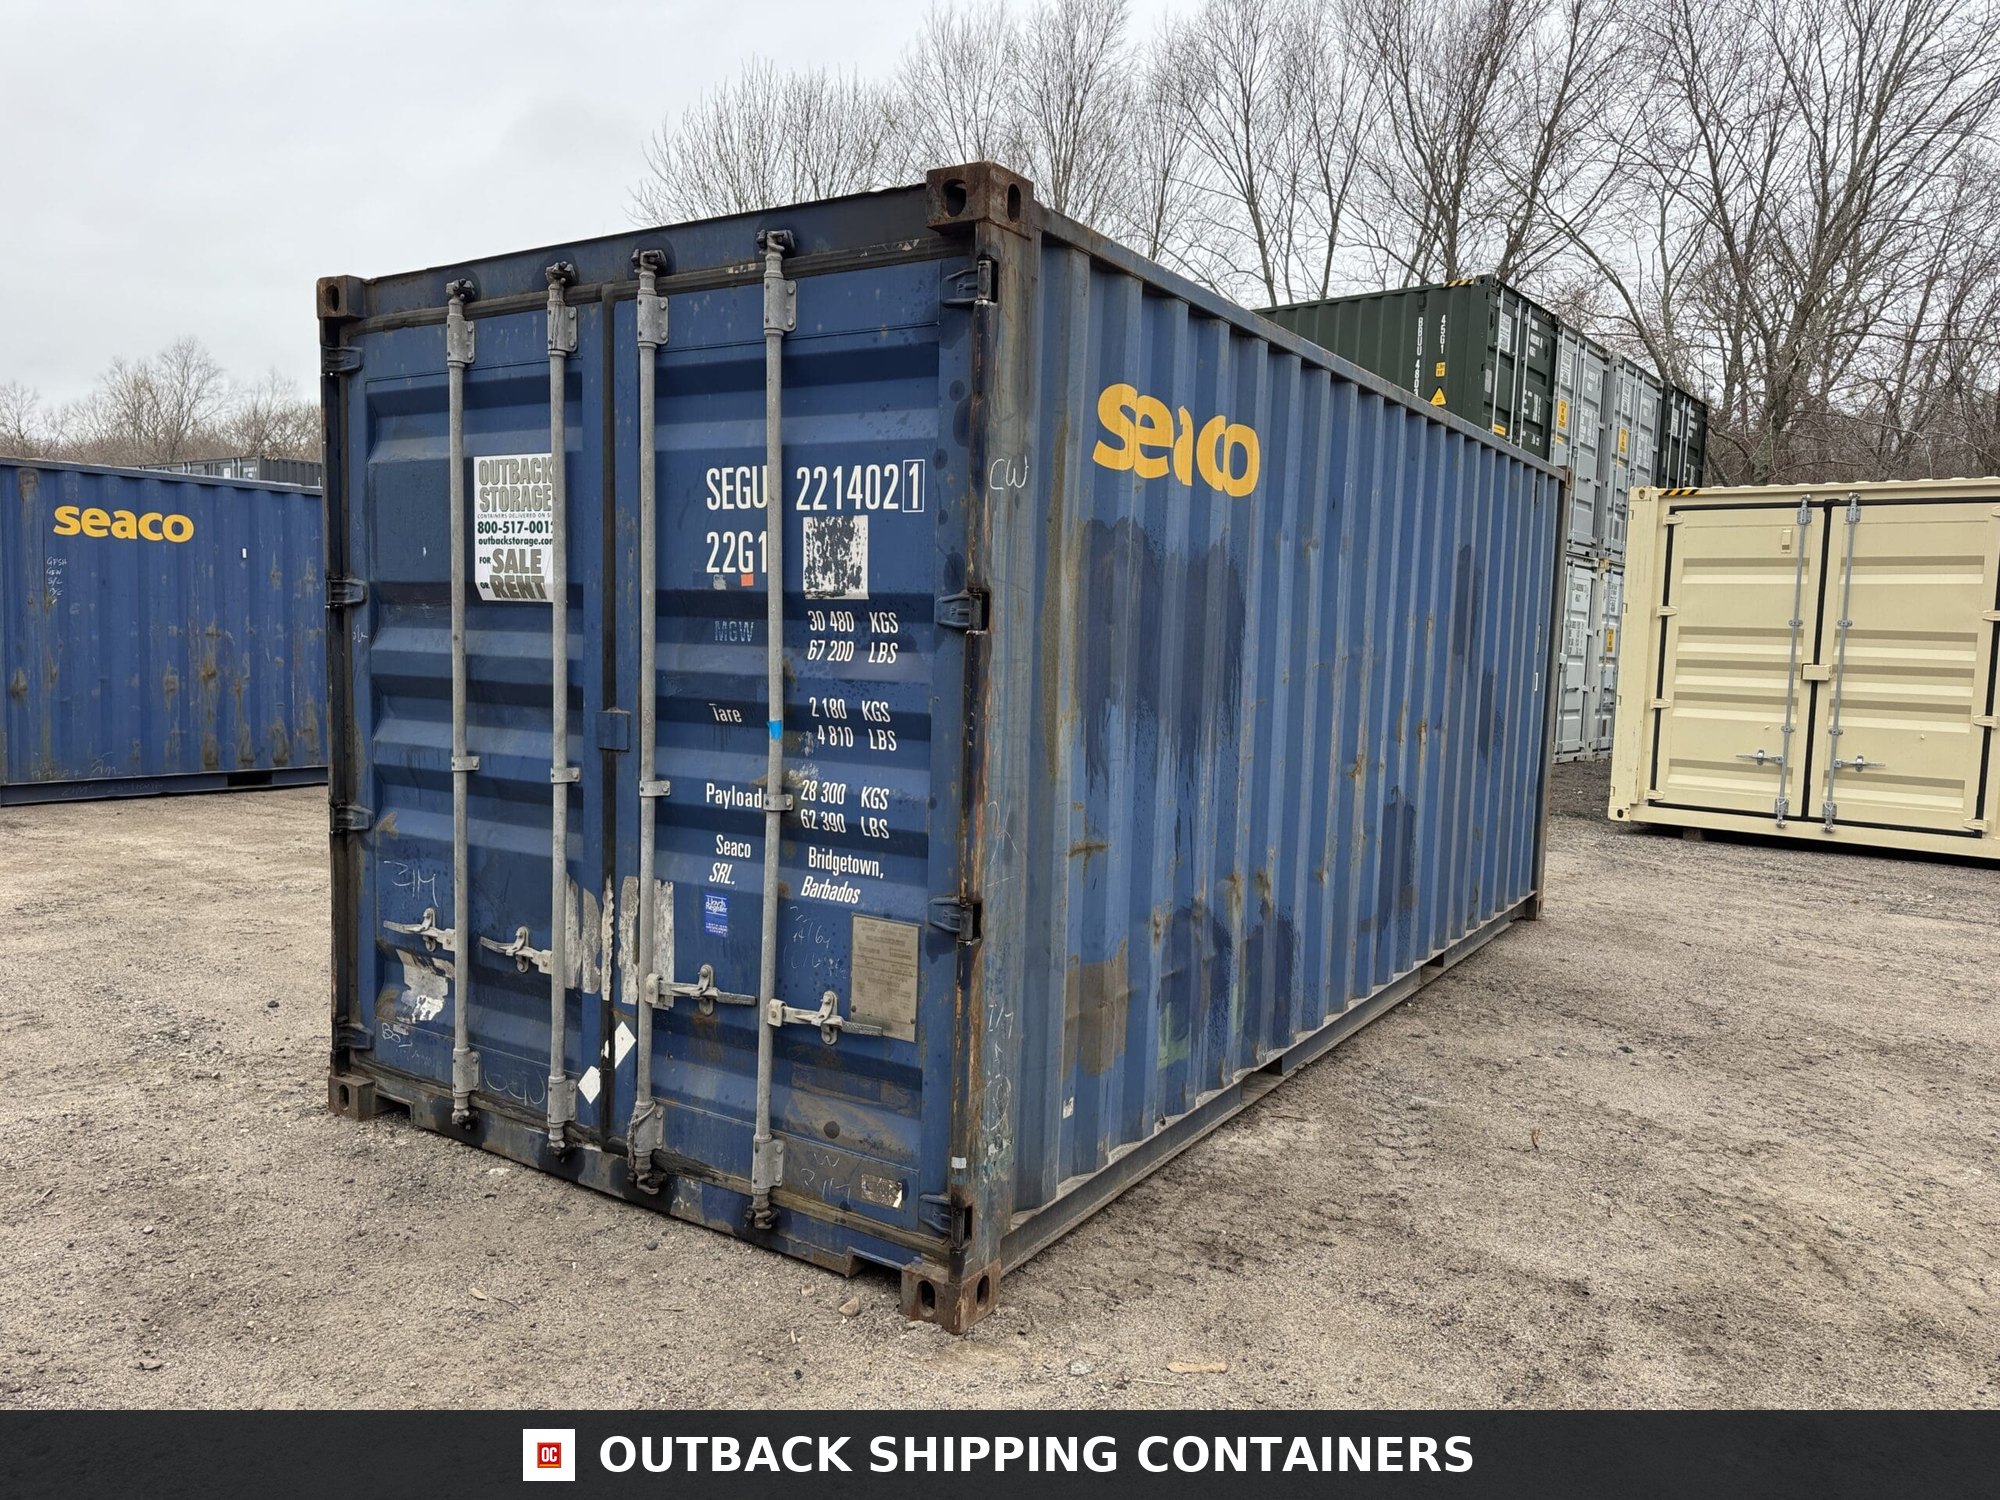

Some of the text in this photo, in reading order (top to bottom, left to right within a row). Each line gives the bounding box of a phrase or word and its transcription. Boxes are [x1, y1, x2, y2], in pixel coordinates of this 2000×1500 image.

[479, 456, 553, 486] OUTBACK
[479, 485, 552, 513] STORAGE
[706, 465, 767, 510] SEGU
[53, 505, 195, 543] seaco
[492, 548, 542, 574] SALE
[706, 531, 767, 573] 22G1
[490, 575, 547, 599] RENT
[714, 610, 899, 642] MGW 30 480 KGS
[807, 640, 899, 664] 67 200 LBS
[708, 703, 742, 723] Tare
[822, 698, 847, 720] 180
[861, 700, 891, 723] KGS
[828, 726, 854, 748] 810
[868, 728, 897, 751] LBS
[705, 780, 890, 810] Payload 28 300 KGS
[800, 809, 890, 839] 62 390 LBS
[716, 834, 884, 879] Seaco Bridgetown,
[709, 862, 860, 904] SRL. Barbados
